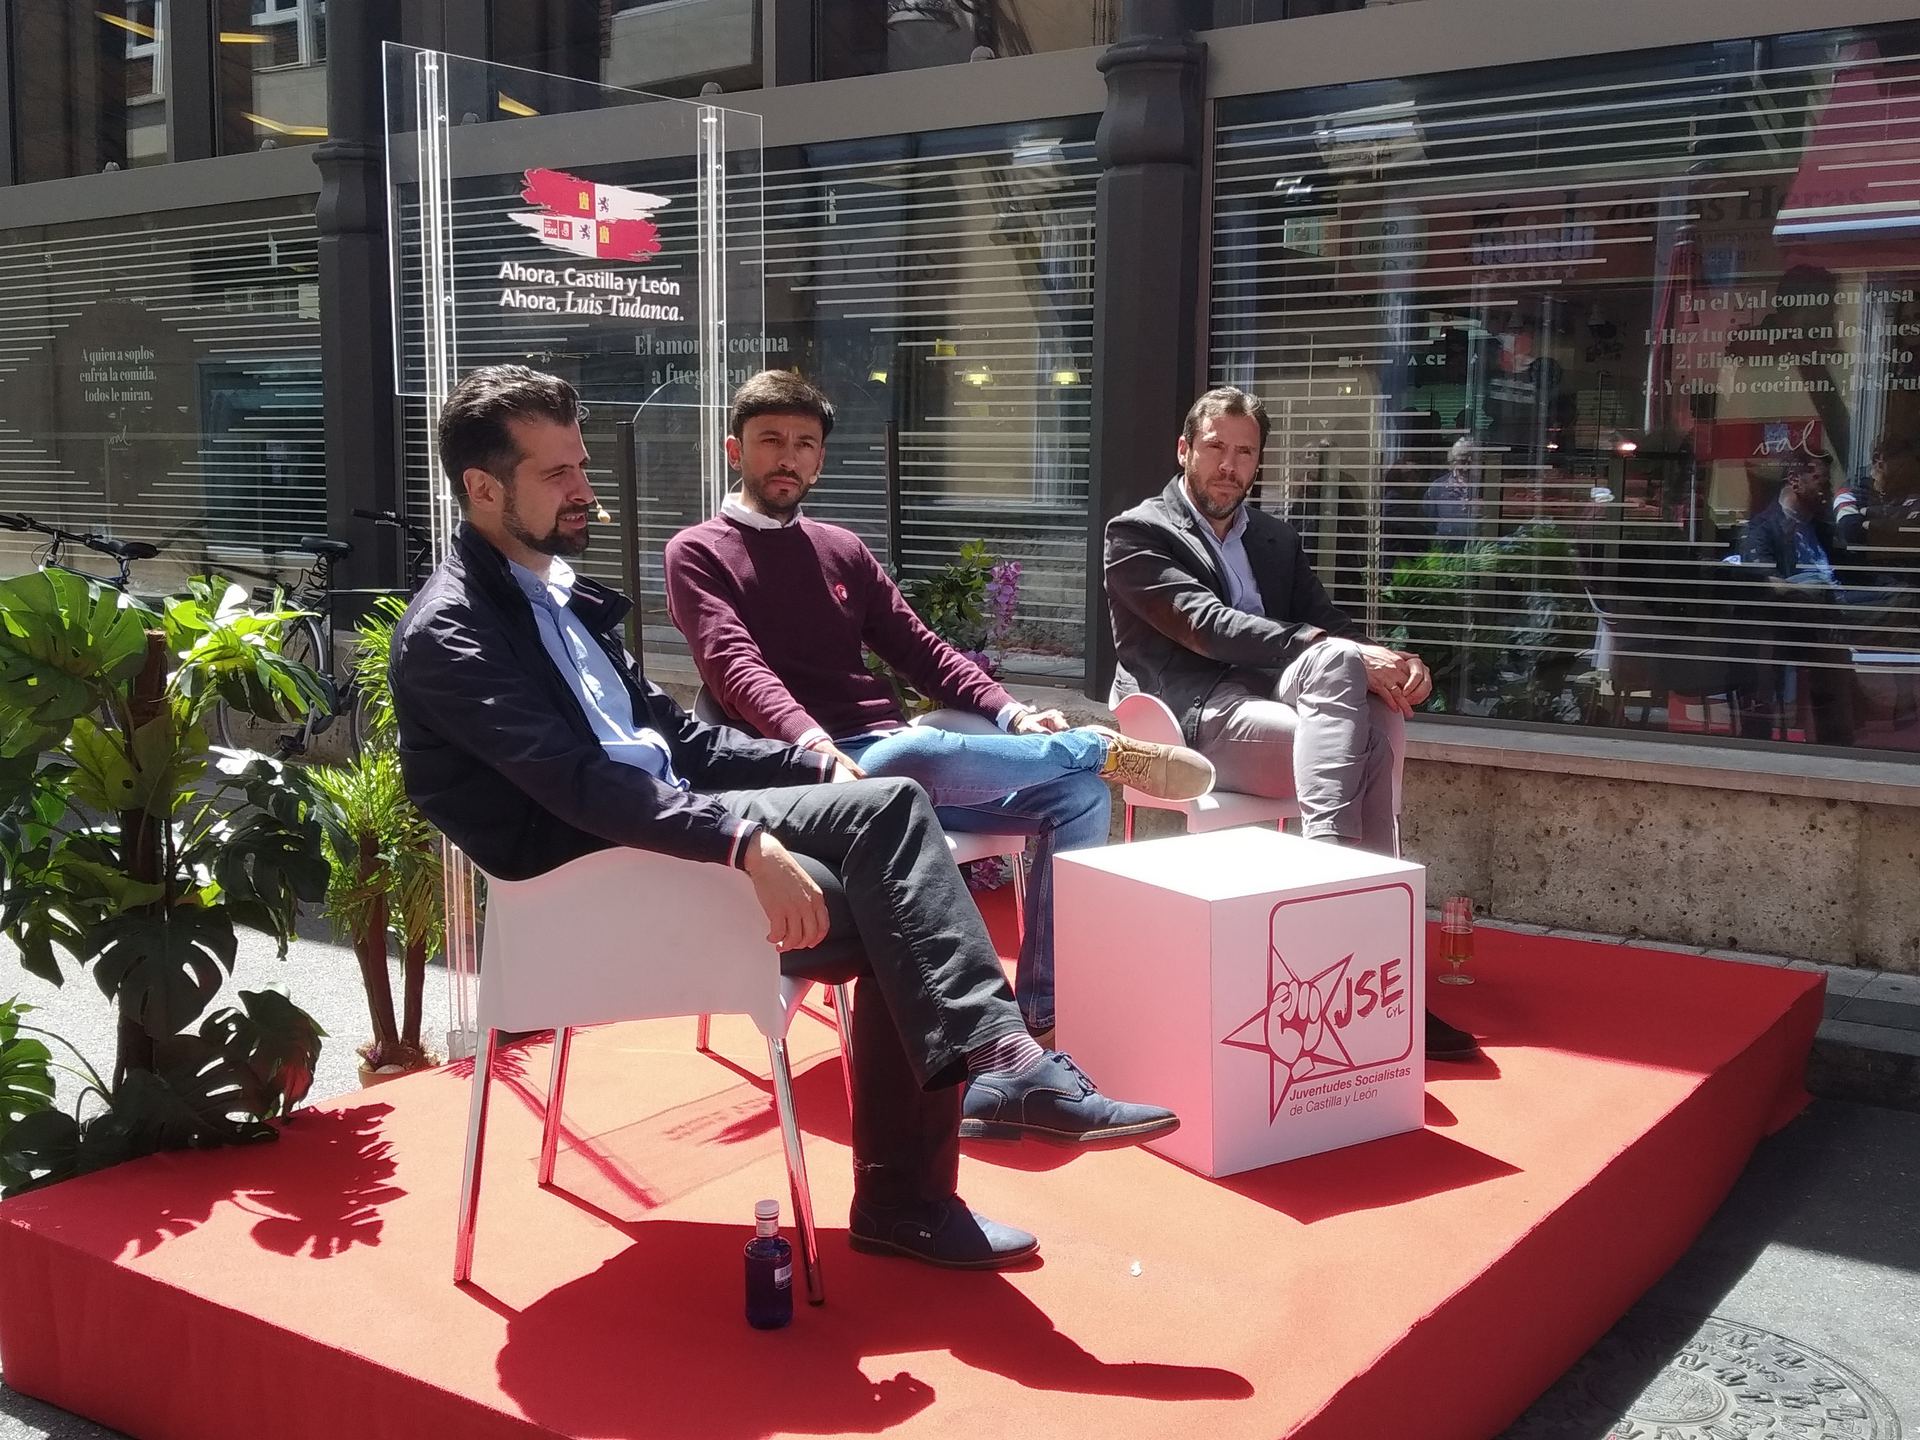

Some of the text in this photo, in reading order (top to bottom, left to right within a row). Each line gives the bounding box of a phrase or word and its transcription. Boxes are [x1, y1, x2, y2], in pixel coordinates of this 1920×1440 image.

[499, 261, 681, 297] Ahora, Castilla y León
[499, 289, 685, 321] Ahora, Luis Tudanca.
[1679, 289, 1914, 312] En el Val como en casa
[635, 334, 652, 356] El
[728, 331, 790, 354] cocina
[1661, 328, 1698, 345] Haz
[1703, 329, 1723, 343] tu
[1727, 326, 1803, 345] compra
[1808, 325, 1833, 339] en
[1838, 320, 1866, 338] los
[82, 345, 155, 366] A quien a soplos
[1675, 353, 1691, 369] 2.
[1696, 352, 1744, 373] Elige
[1749, 354, 1774, 367] un
[79, 365, 157, 382] enfría la comida,
[651, 369, 662, 385] a
[1664, 379, 1676, 395] Y
[1680, 378, 1724, 395] ellos
[1729, 378, 1747, 394] lo
[1750, 376, 1836, 394] cocinan.
[85, 386, 153, 402] todos le miran.
[1752, 420, 1830, 458] val
[1333, 957, 1405, 1029] JSE
[1289, 1066, 1411, 1101] Juventudes Socialistas
[1289, 1087, 1378, 1116] de Castilla y León
